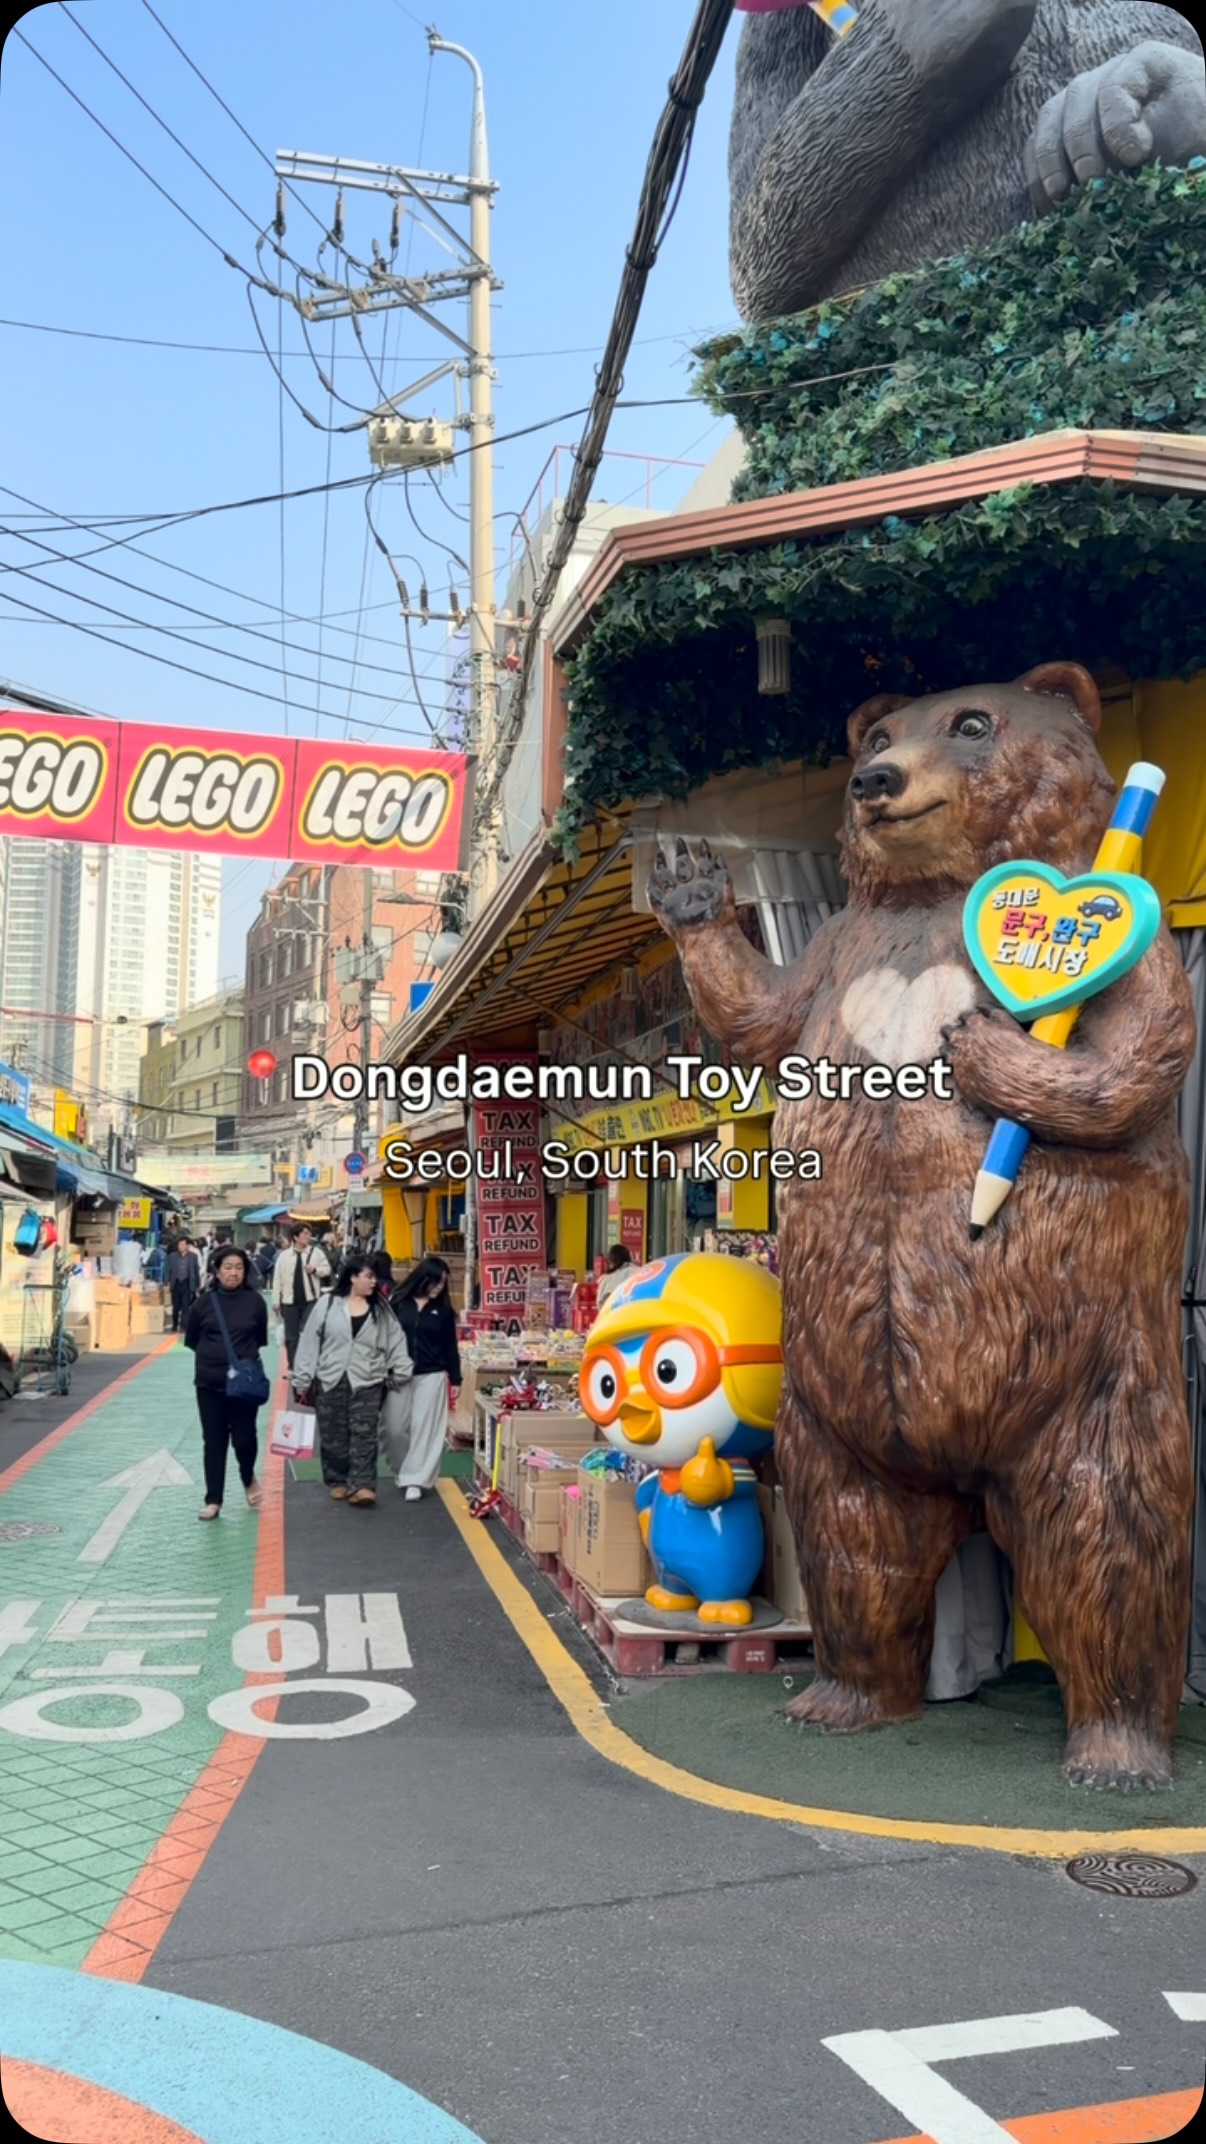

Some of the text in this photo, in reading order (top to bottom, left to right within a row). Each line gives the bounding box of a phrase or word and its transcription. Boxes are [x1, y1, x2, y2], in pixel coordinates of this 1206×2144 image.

[0, 733, 451, 848] EGO LEGO LEGO
[993, 888, 1040, 909] 동대문
[481, 1110, 535, 1132] TAX
[482, 1187, 538, 1200] REFUND
[485, 1213, 537, 1235] TAX
[623, 1216, 642, 1229] TAX
[484, 1238, 540, 1252] REFUND
[486, 1291, 526, 1304] REFU
